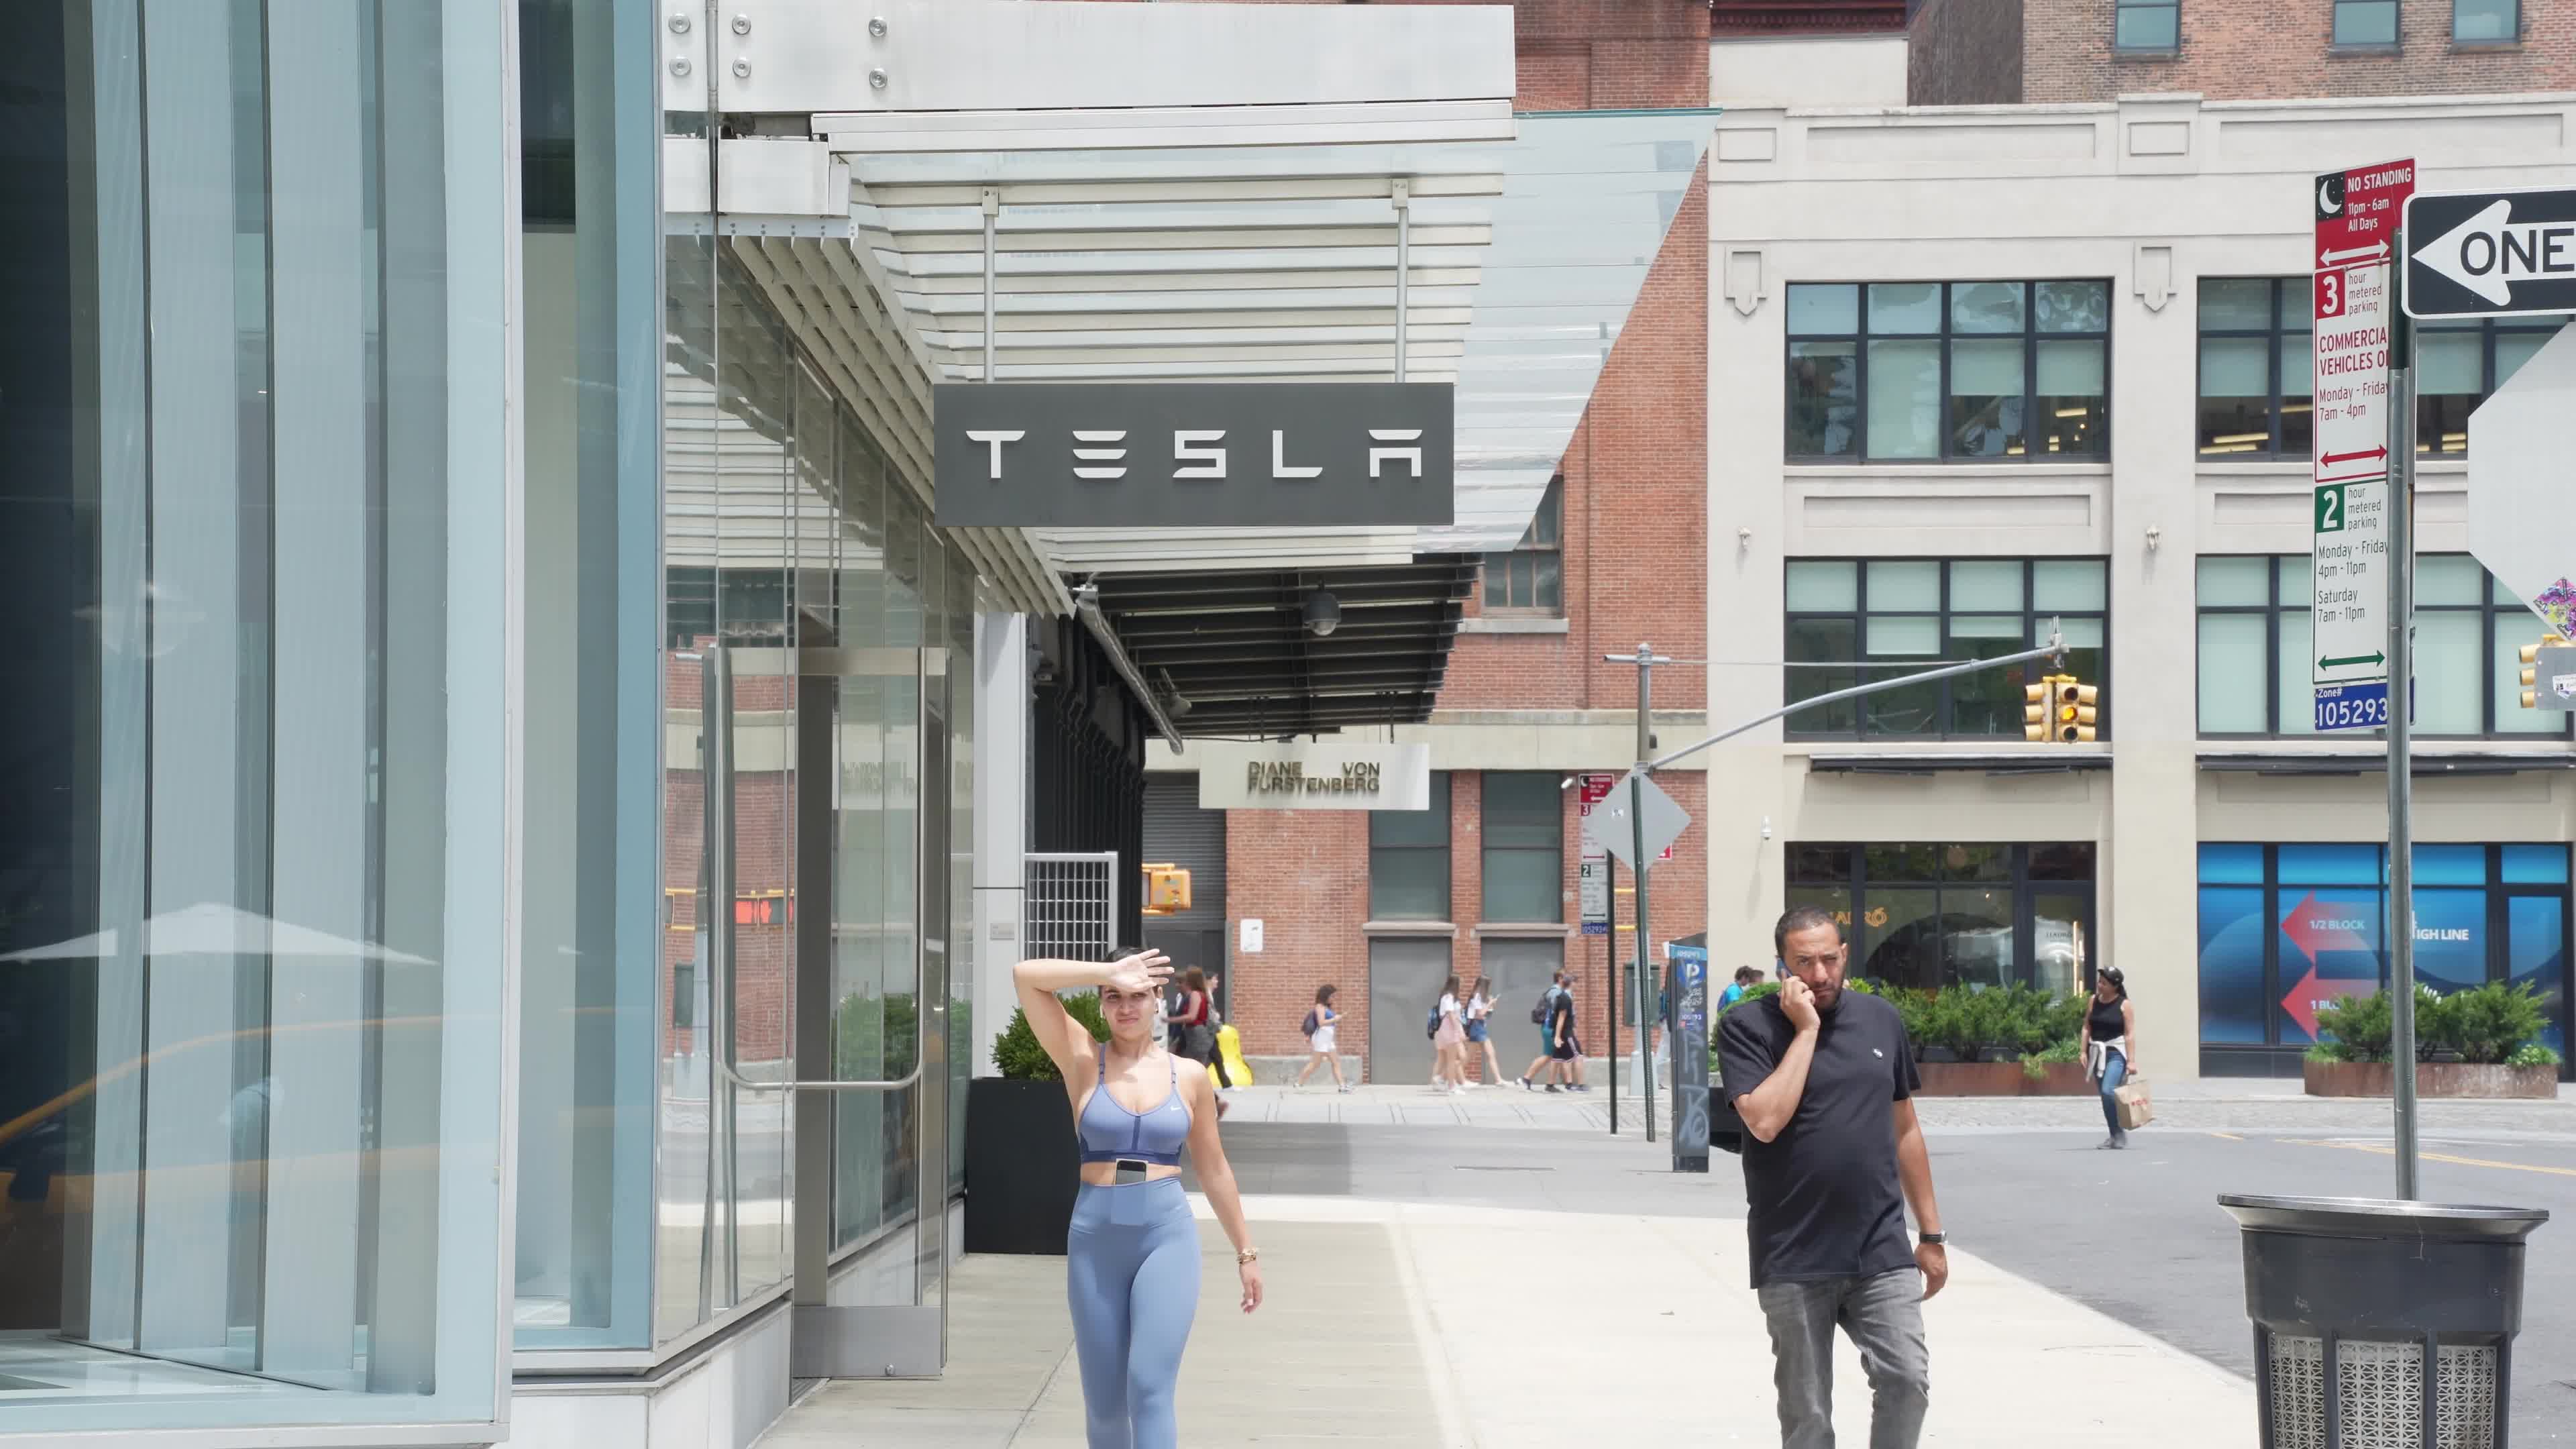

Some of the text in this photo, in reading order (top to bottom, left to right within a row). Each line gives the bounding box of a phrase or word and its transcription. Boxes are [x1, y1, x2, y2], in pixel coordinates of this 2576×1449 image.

[2348, 167, 2412, 193] NO STANDING
[2348, 202, 2365, 217] 11pm
[2371, 198, 2390, 211] 6am
[2348, 218, 2378, 232] All Days
[2460, 227, 2575, 276] ONE
[2349, 274, 2367, 284] hour
[2322, 275, 2339, 314] 3
[2349, 284, 2382, 300] metered
[2349, 301, 2378, 317] parking
[2320, 327, 2387, 353] COMMERCIA
[2320, 352, 2373, 376] VEHICLES
[2319, 386, 2353, 402] Monday
[2319, 407, 2338, 422] 7am
[2347, 404, 2366, 419] 4pm
[965, 429, 1423, 478] TESLA
[2349, 488, 2366, 499] hour
[2323, 490, 2338, 529] 2
[2349, 499, 2381, 514] metered
[2348, 515, 2377, 531] parking
[2318, 543, 2352, 559] Monday
[2361, 539, 2388, 556] Friday
[2318, 564, 2337, 580] 4pm
[2346, 561, 2366, 578] 11pm
[2318, 587, 2358, 604] Saturday
[2318, 608, 2336, 623] 7am
[2345, 606, 2365, 623] 11pm
[2318, 687, 2343, 698] Zone#
[2318, 698, 2388, 727] 105293
[1248, 761, 1380, 776] DIANE VON
[1248, 777, 1380, 792] FURSTENBERG
[1583, 804, 1589, 815] 3
[1583, 865, 1589, 877] 2
[2310, 920, 2365, 930] 1/2 BLOCK
[2441, 929, 2469, 941] LINE
[1686, 963, 1700, 977] P
[2310, 1000, 2317, 1010] 1
